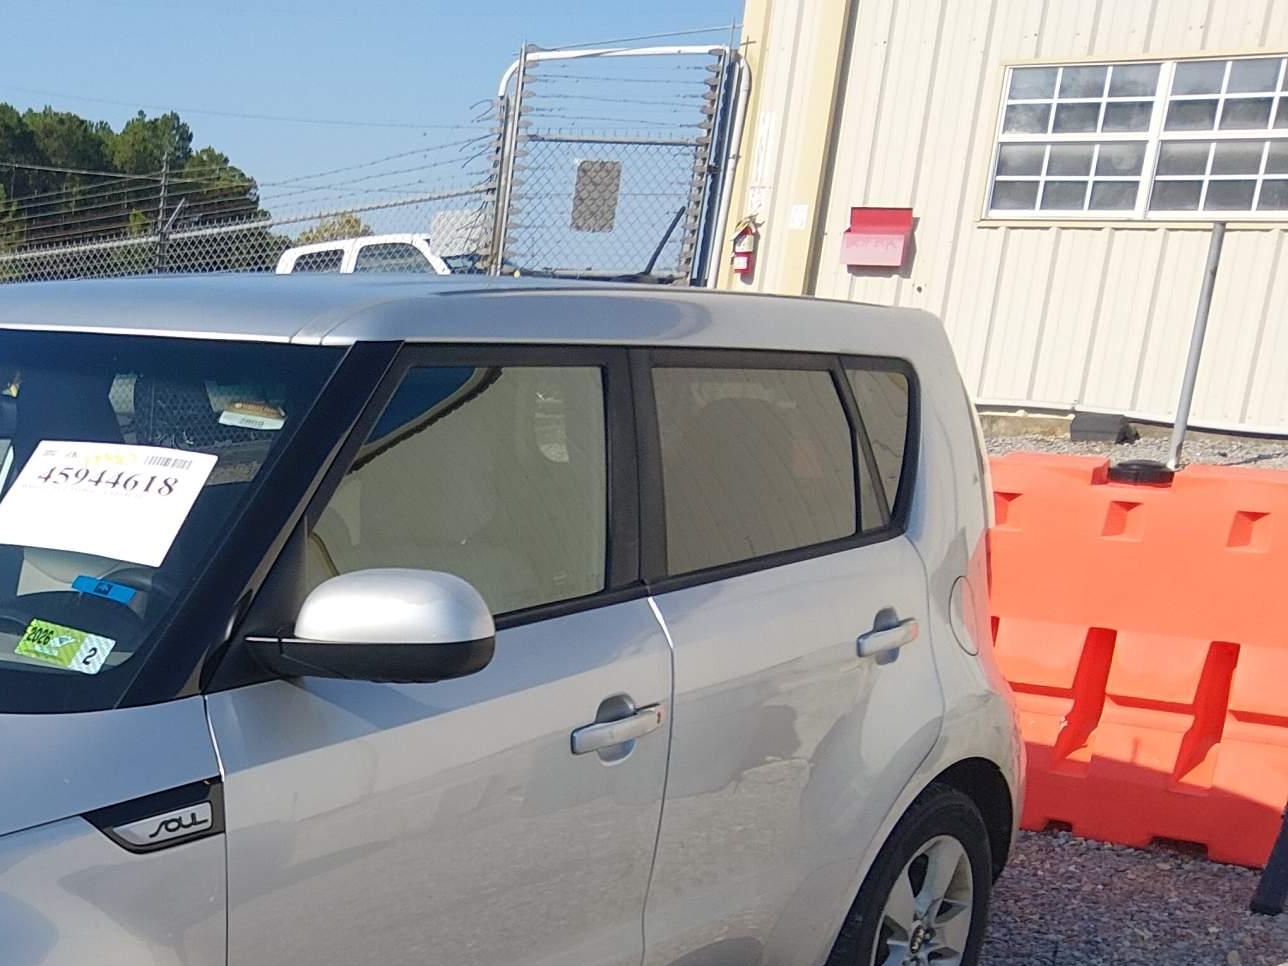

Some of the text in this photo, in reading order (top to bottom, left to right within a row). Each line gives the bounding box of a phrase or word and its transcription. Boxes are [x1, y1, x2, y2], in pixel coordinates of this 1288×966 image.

[37, 466, 179, 497] 45944618
[25, 626, 54, 646] 2026
[82, 647, 98, 666] 2
